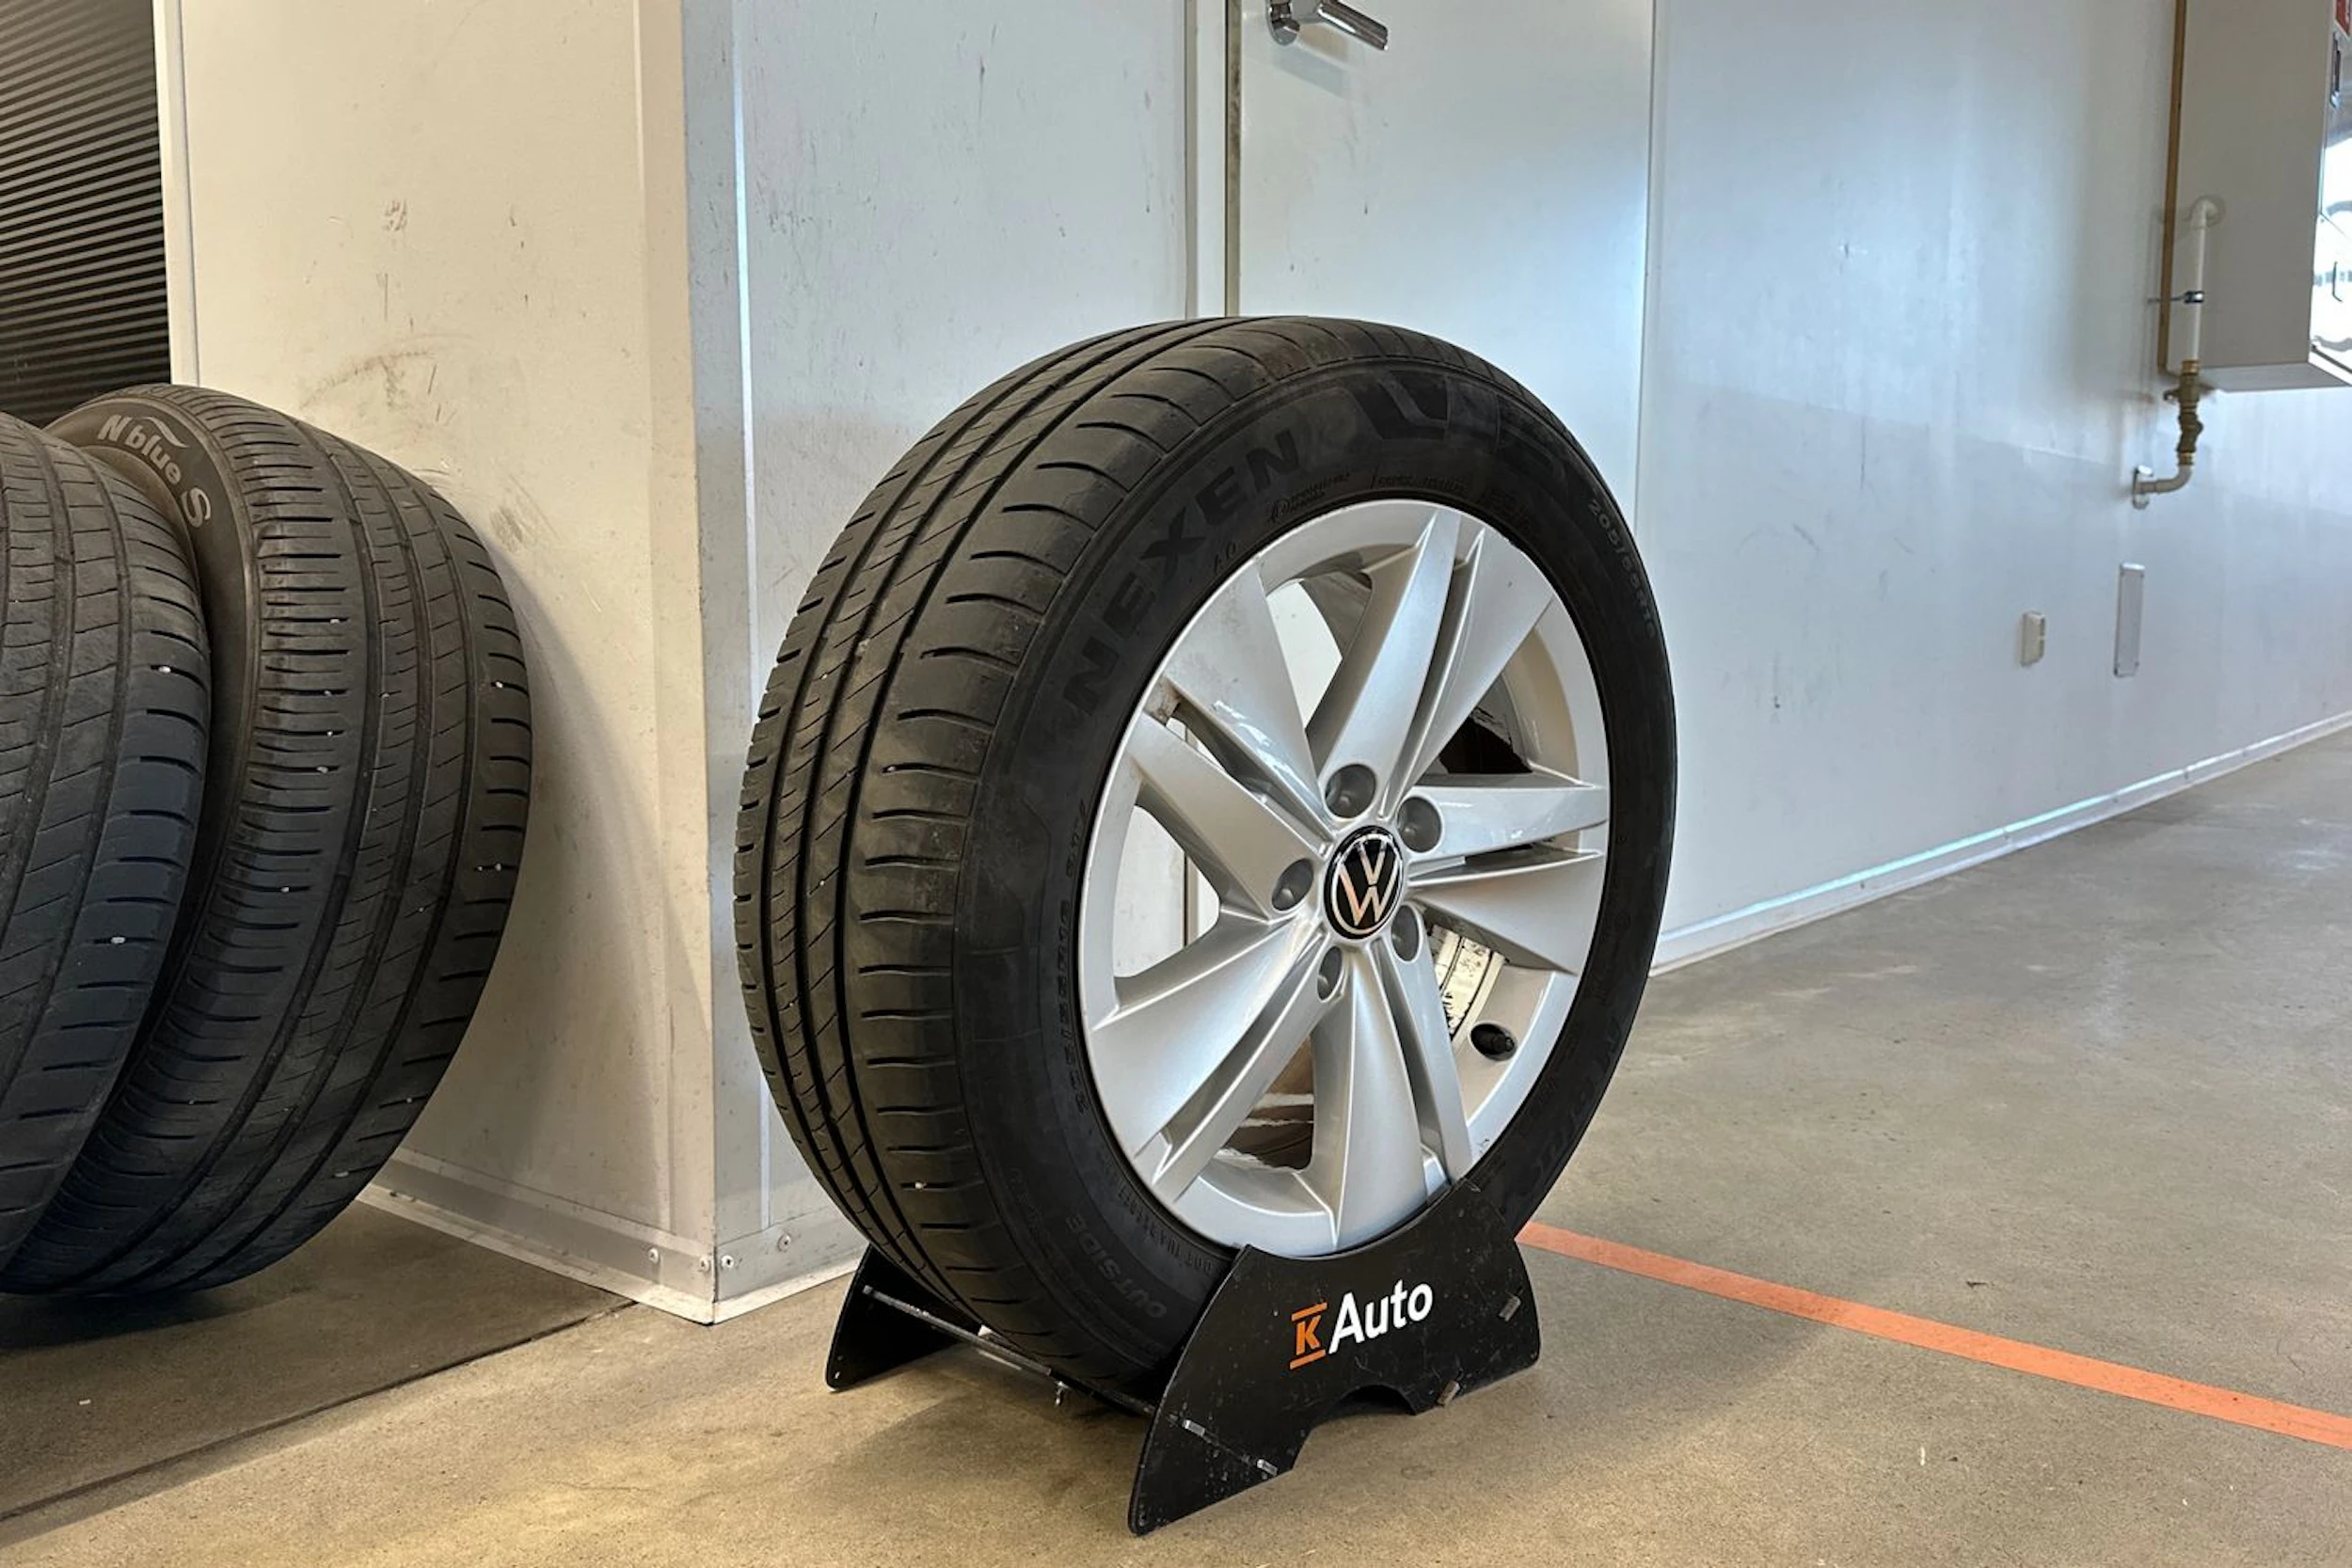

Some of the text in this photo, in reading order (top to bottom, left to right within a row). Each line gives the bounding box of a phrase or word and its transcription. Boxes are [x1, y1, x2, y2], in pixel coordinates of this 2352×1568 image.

[1062, 429, 1303, 716] NEXEN
[1065, 1214, 1168, 1316] OUTSIDE
[1293, 1278, 1434, 1358] K Auto
